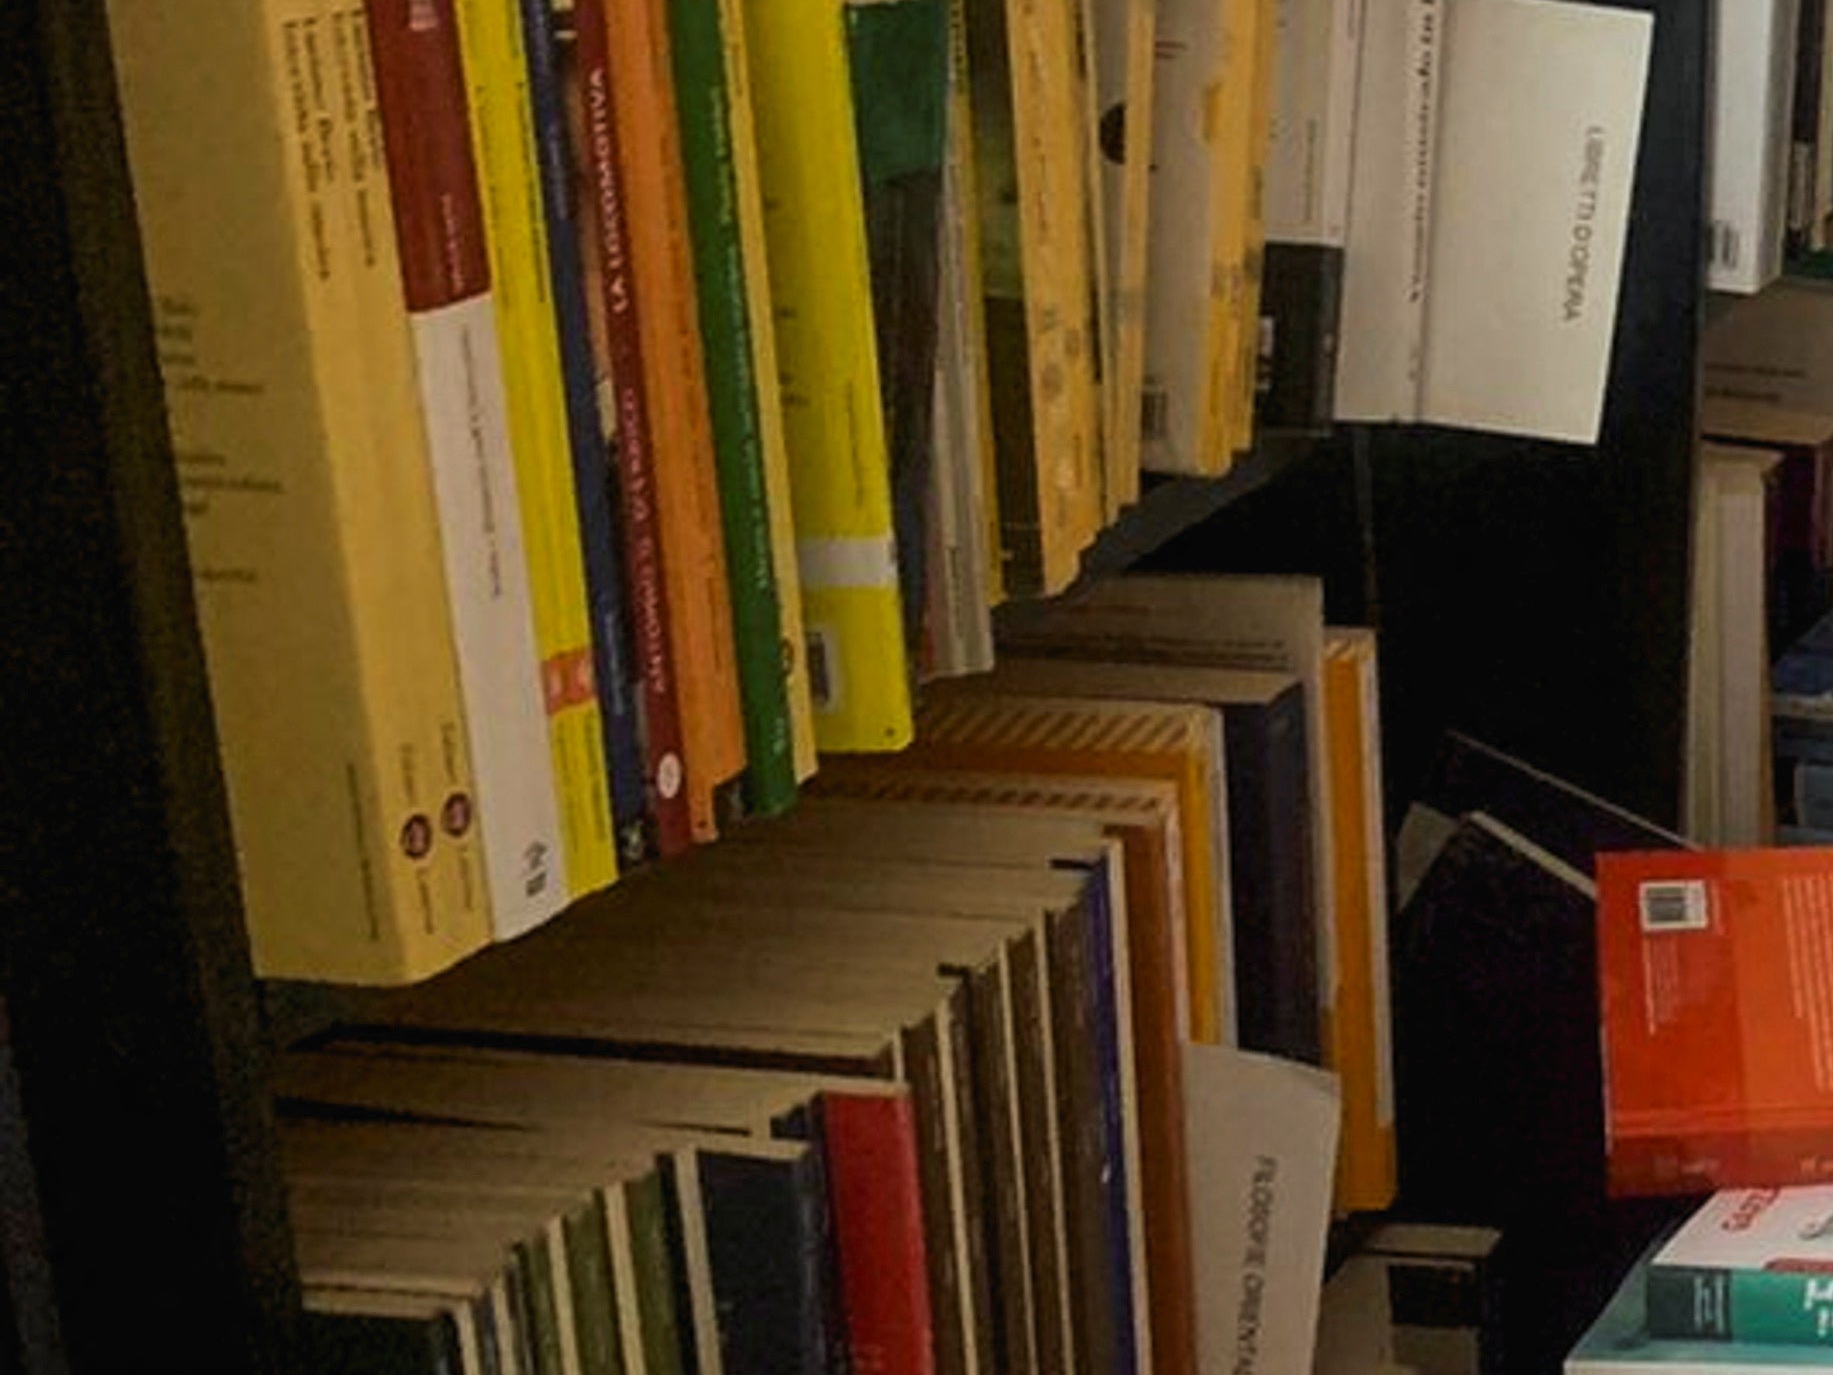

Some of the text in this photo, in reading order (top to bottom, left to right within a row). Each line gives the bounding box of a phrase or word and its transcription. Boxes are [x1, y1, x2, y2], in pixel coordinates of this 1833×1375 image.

[590, 67, 629, 270] LOCOMOTIVA
[607, 275, 630, 314] LA
[1247, 1155, 1277, 1271] FILOSOFIE
